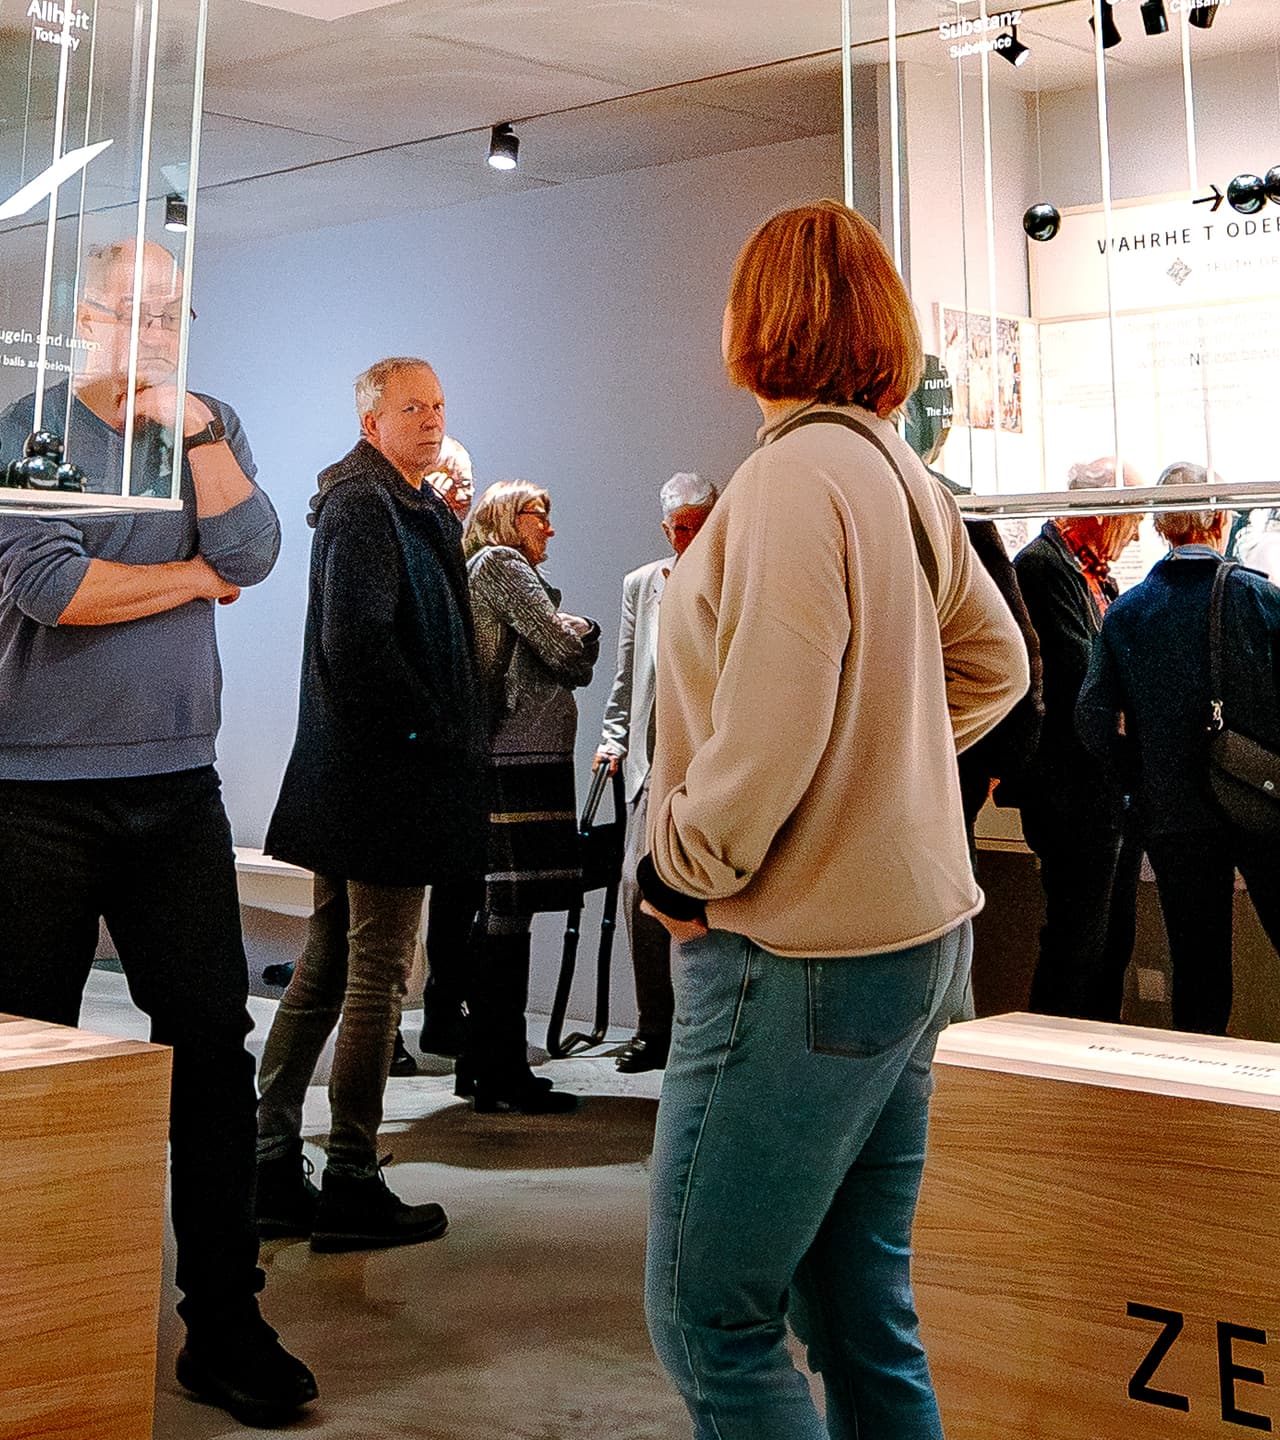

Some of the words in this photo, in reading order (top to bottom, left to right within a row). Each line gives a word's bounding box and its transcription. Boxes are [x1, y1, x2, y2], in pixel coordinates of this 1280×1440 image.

[938, 8, 1024, 42] Substanz
[1097, 224, 1214, 255] WAHRHET
[36, 333, 63, 347] snd
[3, 356, 26, 368] balls
[28, 360, 43, 369] ar
